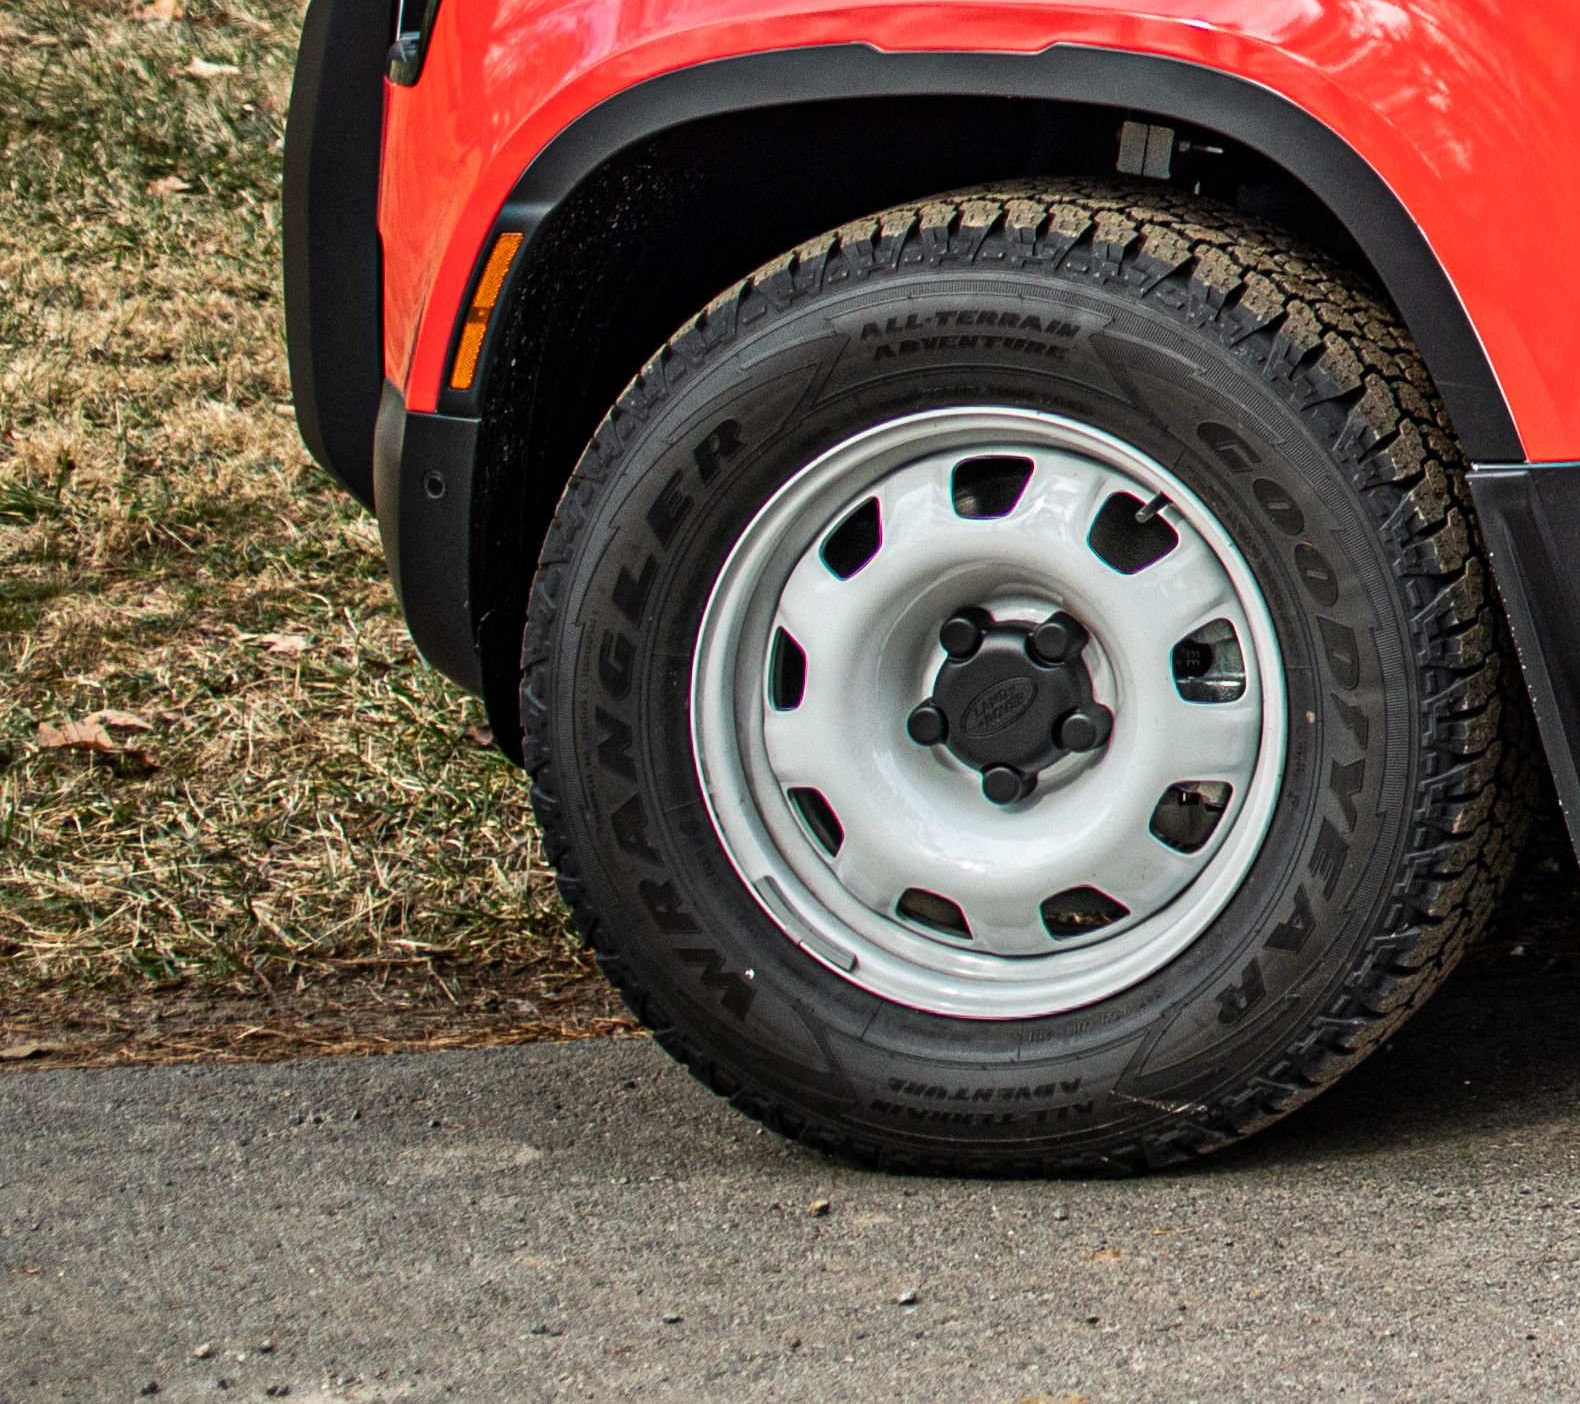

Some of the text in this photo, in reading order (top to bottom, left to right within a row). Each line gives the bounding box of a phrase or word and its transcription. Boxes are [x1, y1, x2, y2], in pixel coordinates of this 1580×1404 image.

[860, 309, 1081, 339] ALL-TERRAIN
[873, 334, 1072, 360] ADVENTURE
[594, 416, 757, 1022] WRANGLER
[1196, 420, 1370, 1026] GOODYEAR
